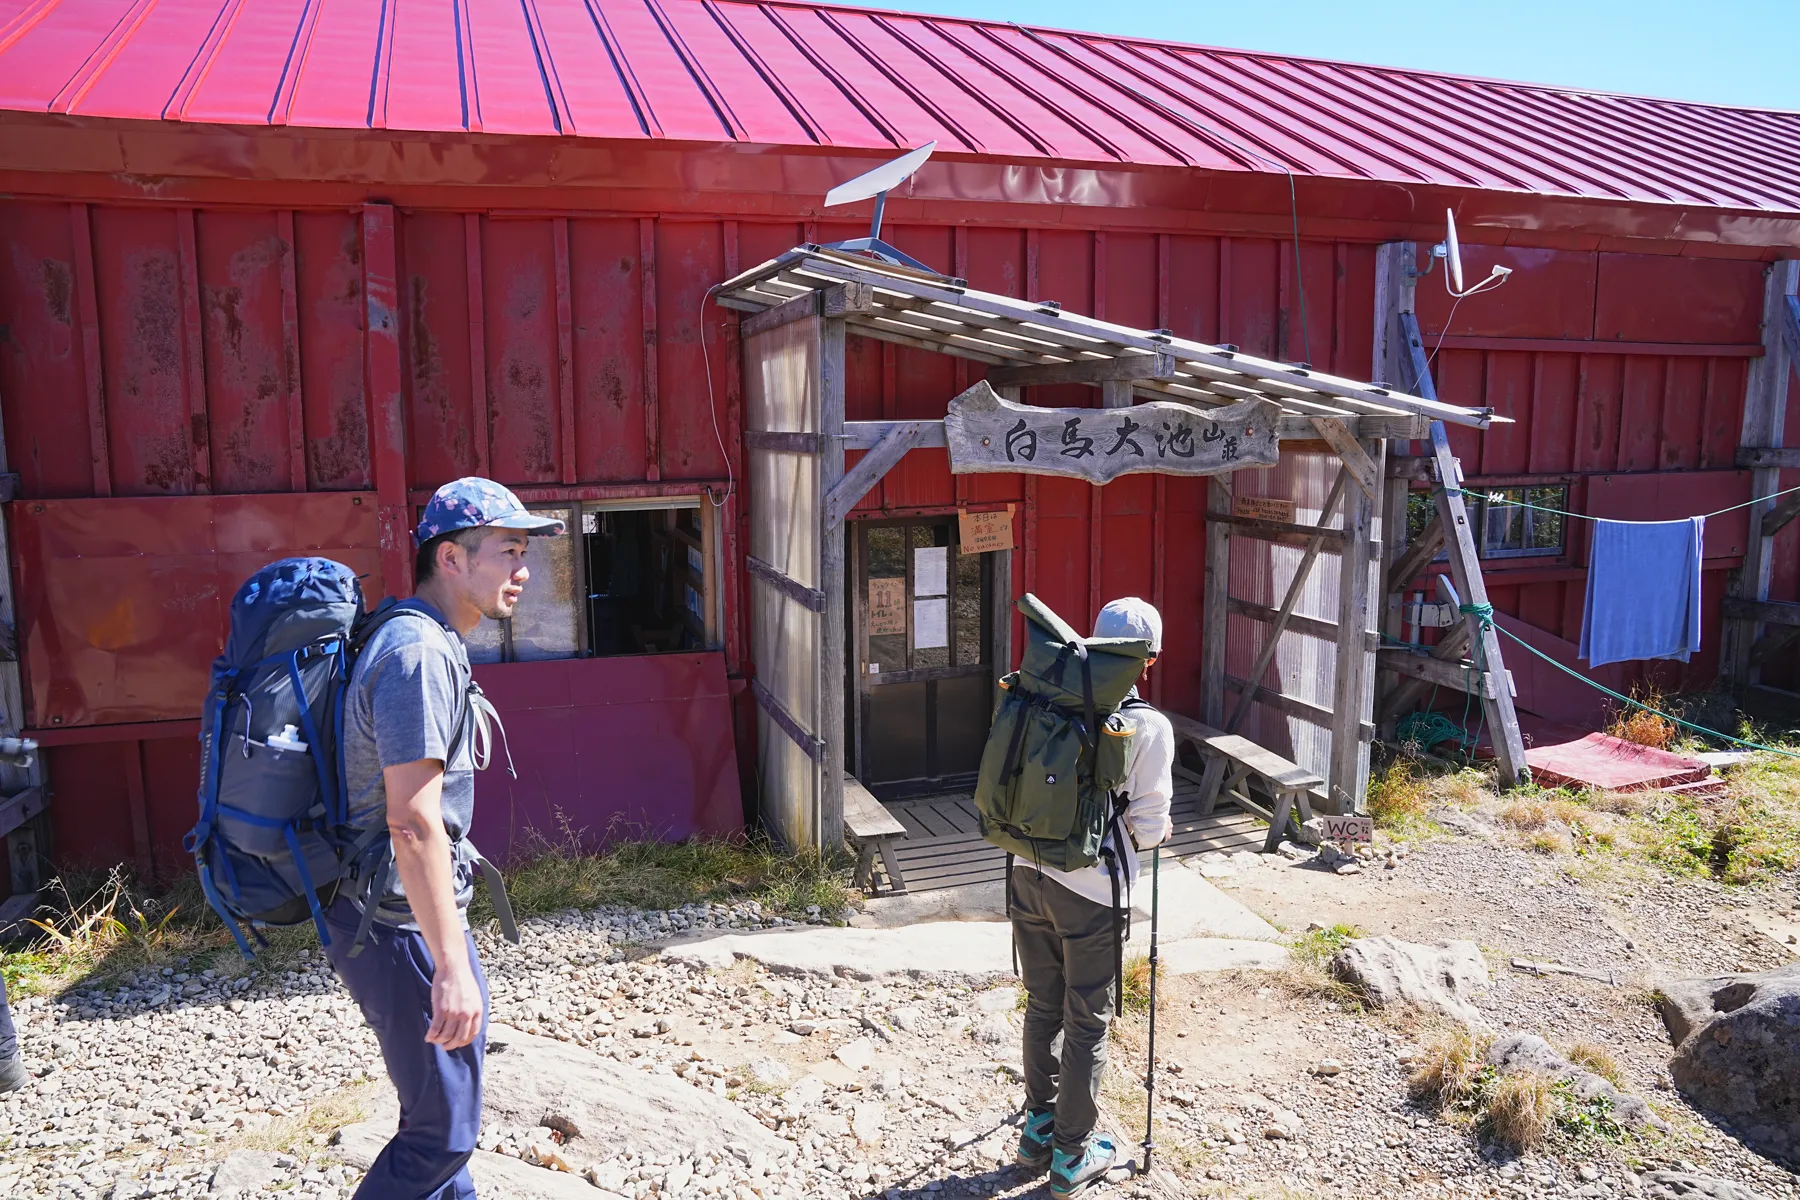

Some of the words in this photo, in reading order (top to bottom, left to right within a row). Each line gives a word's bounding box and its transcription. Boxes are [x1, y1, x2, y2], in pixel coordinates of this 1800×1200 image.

[1005, 416, 1240, 462] 白馬大池山荘
[973, 513, 998, 522] 本日は
[963, 545, 975, 553] No
[977, 542, 1005, 551] vacancy
[1328, 820, 1359, 836] WC
